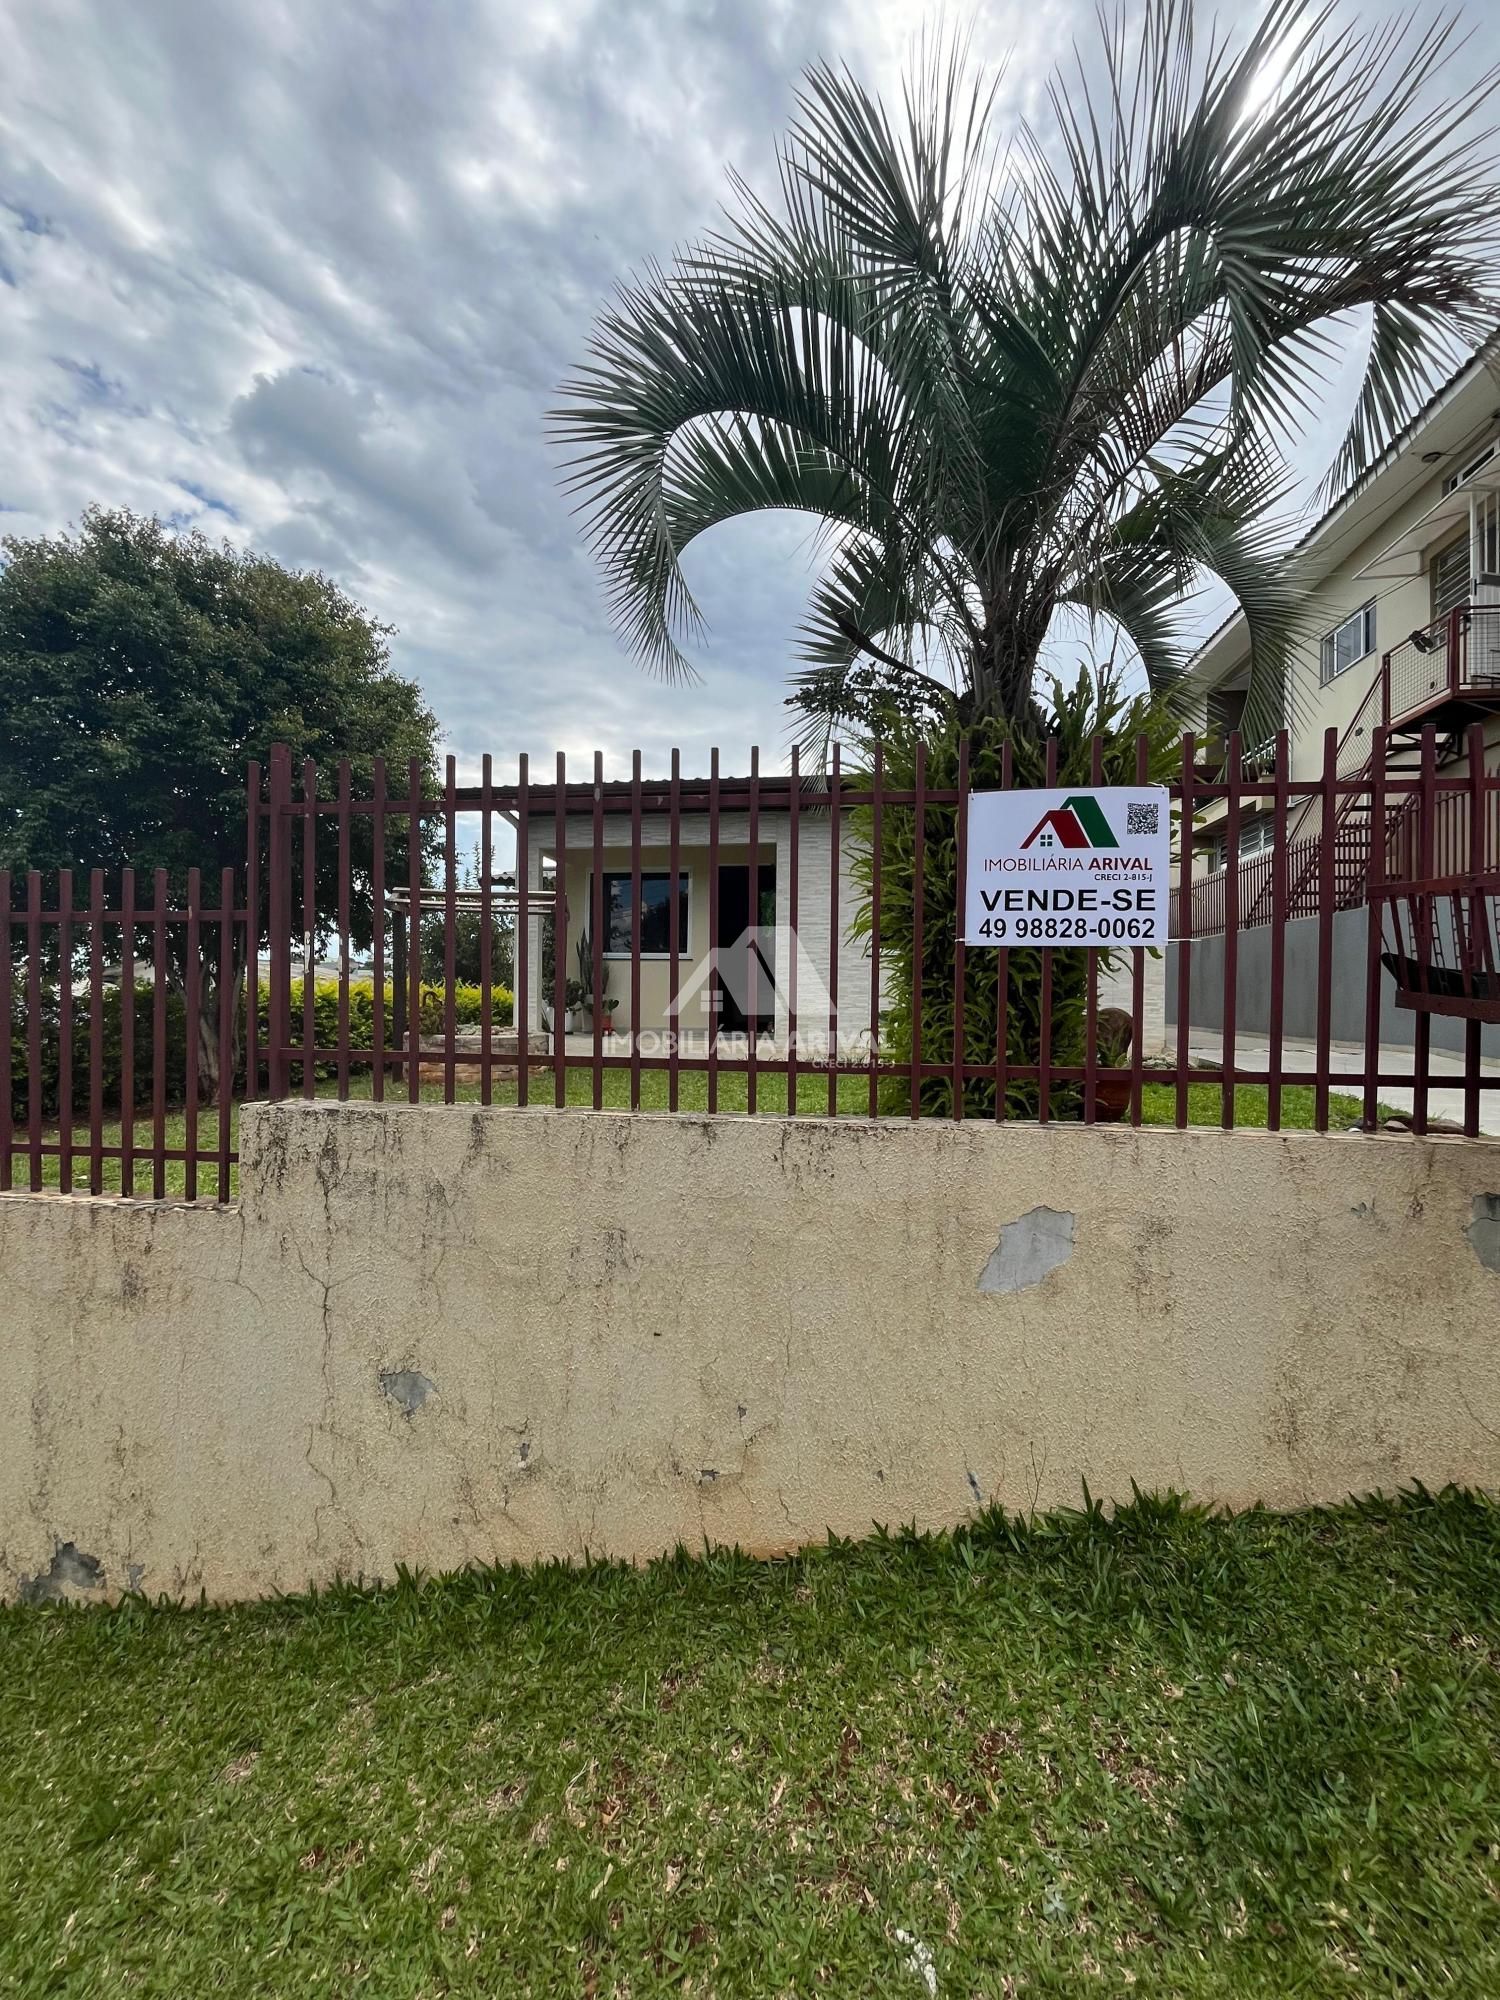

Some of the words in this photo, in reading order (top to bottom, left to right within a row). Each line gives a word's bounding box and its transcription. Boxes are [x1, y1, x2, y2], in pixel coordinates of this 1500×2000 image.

[985, 853, 1084, 872] IMOBILIÁRIA
[1088, 857, 1153, 871] ARIVAL
[1094, 873, 1121, 881] CRECI
[1123, 873, 1153, 882] 2-815-J
[980, 888, 1156, 912] VENDE-SE
[979, 917, 1007, 939] 49
[1015, 917, 1155, 939] 98828-0062
